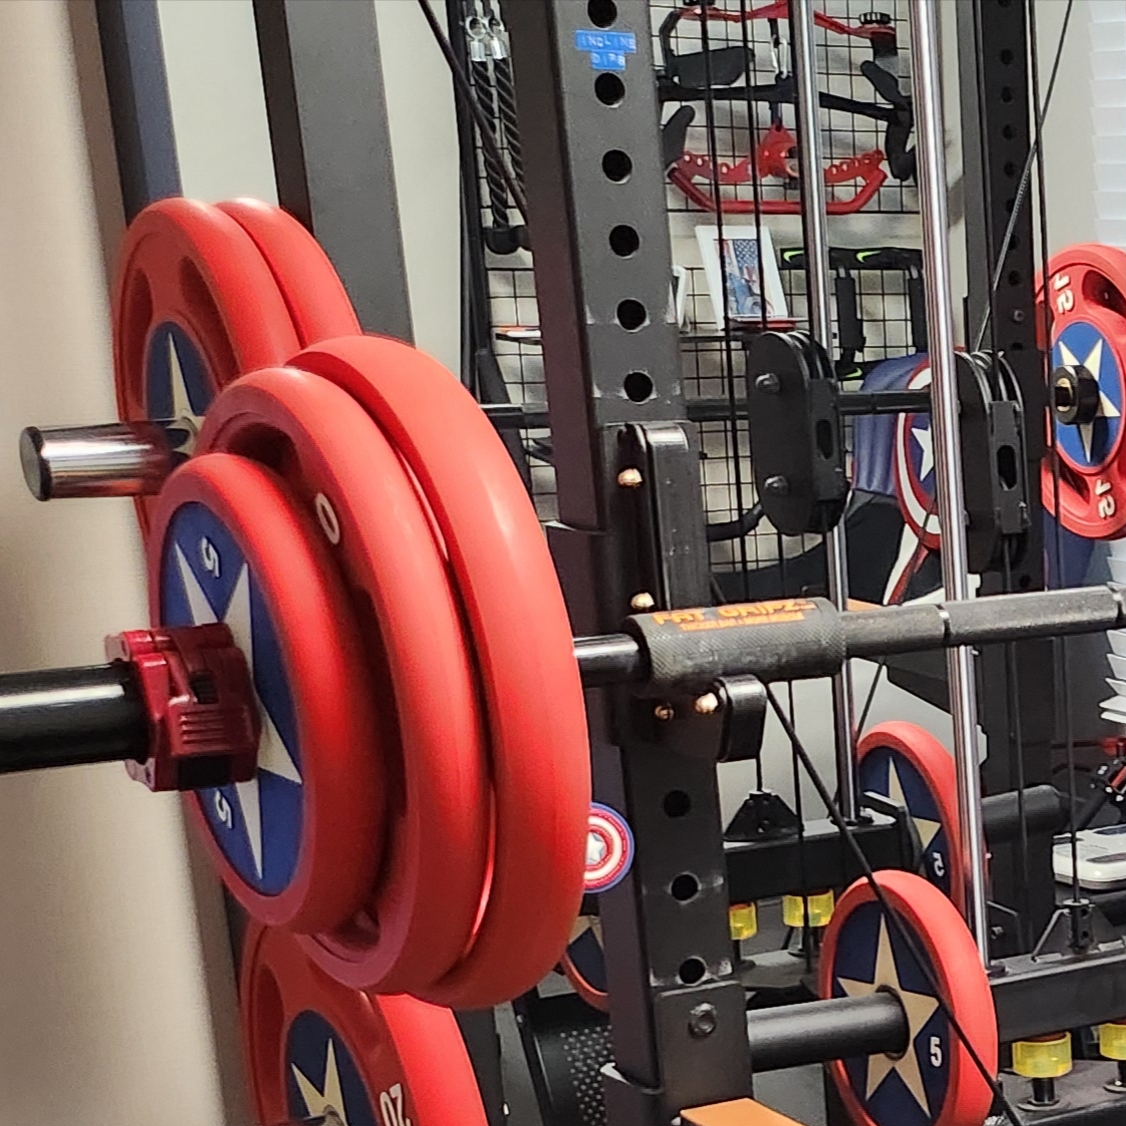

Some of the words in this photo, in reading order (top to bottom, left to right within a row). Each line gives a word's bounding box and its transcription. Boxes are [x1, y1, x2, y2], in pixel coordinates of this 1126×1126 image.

[201, 536, 220, 578] 5
[652, 608, 706, 626] FAT
[215, 789, 232, 829] 5
[930, 1036, 942, 1067] 5
